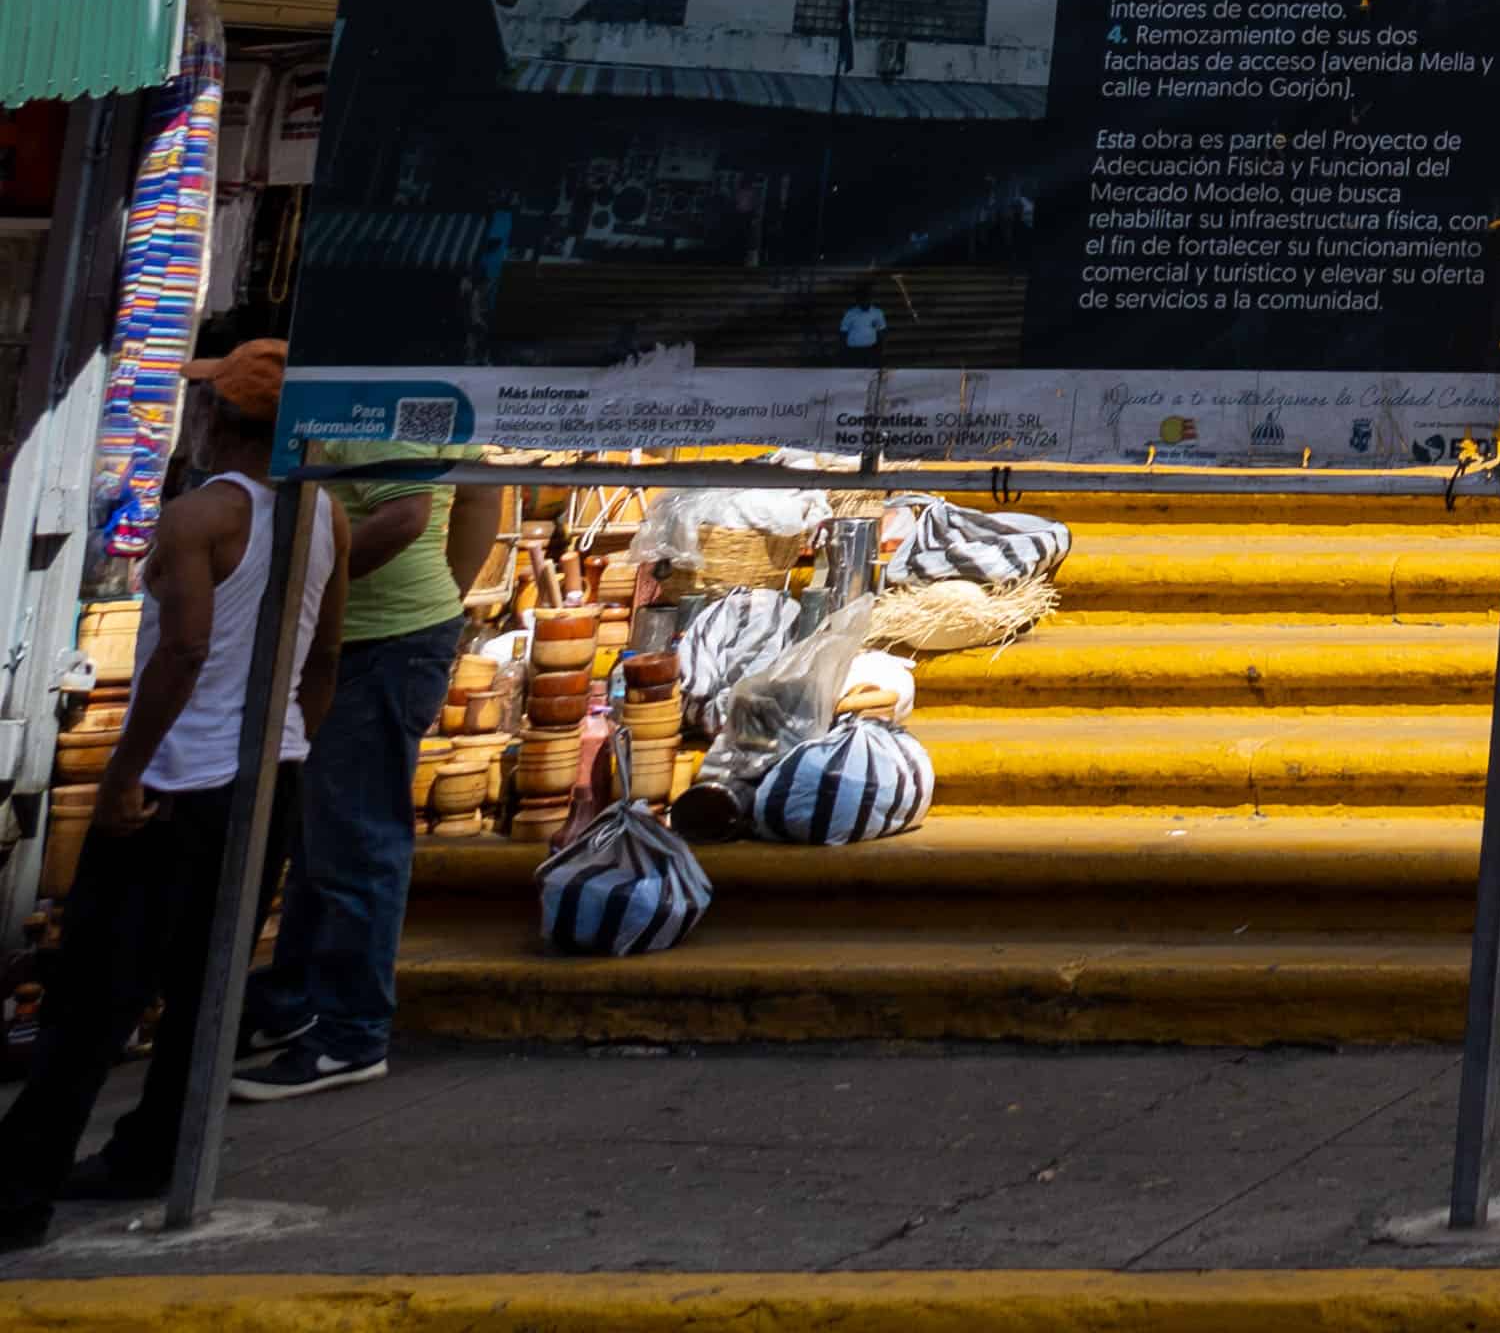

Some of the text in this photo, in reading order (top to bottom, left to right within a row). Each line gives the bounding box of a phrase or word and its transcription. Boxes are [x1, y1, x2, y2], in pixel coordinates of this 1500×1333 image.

[1110, 0, 1347, 21] interiores de concreto.
[1107, 25, 1418, 46] 4. Remozamiento de sus dos
[1103, 51, 1200, 71] fachadas
[1204, 51, 1234, 71] de
[1238, 55, 1316, 72] acceso
[1419, 52, 1475, 72] Mella
[1480, 57, 1494, 76] y
[1101, 77, 1151, 98] calle
[1157, 77, 1263, 98] Hernando
[1095, 129, 1462, 155] Esta obra es parte del Proyecto de
[1090, 155, 1451, 181] Adecuación Física y Funcional del
[1090, 182, 1401, 207] Mercado Modelo, que busca
[1088, 208, 1489, 232] rehabilitar su infraestructura física, con
[1085, 235, 1482, 258] el fin de fortalecer su funcionamiento
[1082, 261, 1485, 288] comercial y turístico y elevar su oferta
[1078, 288, 1383, 310] de servicios a la comunidad.
[497, 385, 528, 400] Más
[1360, 384, 1436, 408] Ciudad
[351, 403, 386, 419] Para
[496, 402, 549, 416] Unidad
[551, 402, 566, 416] de
[678, 402, 699, 416] del
[702, 402, 769, 419] Programa
[291, 417, 386, 434] información
[836, 412, 928, 428] Contratista:
[1016, 412, 1044, 429] SRL
[835, 431, 858, 445] No
[862, 430, 934, 446] Objeción
